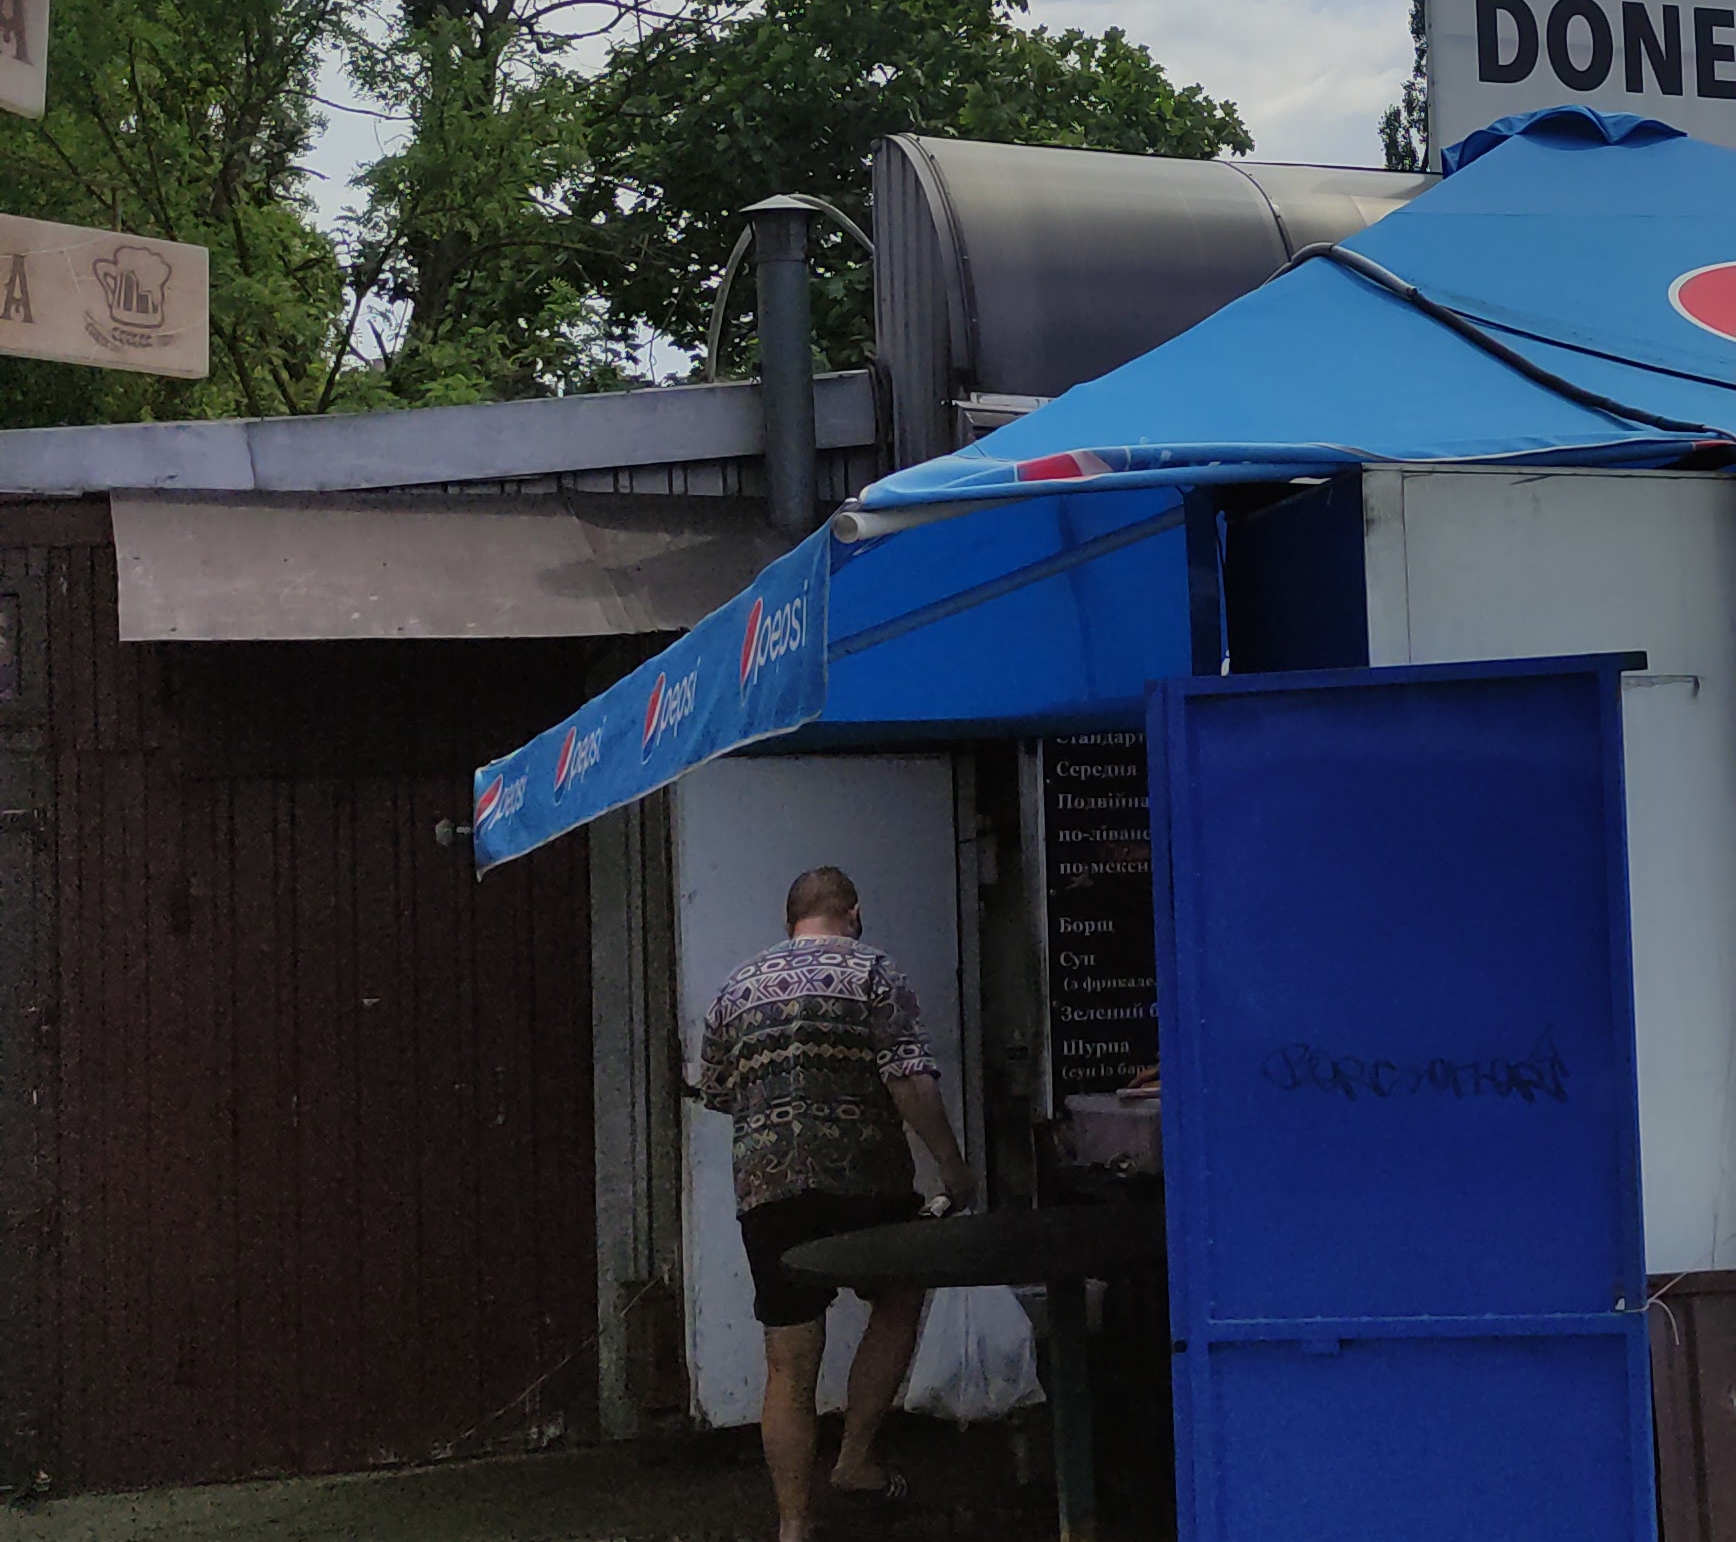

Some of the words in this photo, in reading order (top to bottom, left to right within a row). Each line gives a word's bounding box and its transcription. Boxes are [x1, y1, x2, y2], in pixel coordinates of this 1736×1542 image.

[754, 578, 808, 684] pepsi
[656, 656, 701, 746] pepsi
[567, 716, 607, 791] pepsi
[1059, 917, 1114, 936] Борщ
[1059, 951, 1096, 970] Суп
[1062, 1039, 1130, 1059] Шурпа
